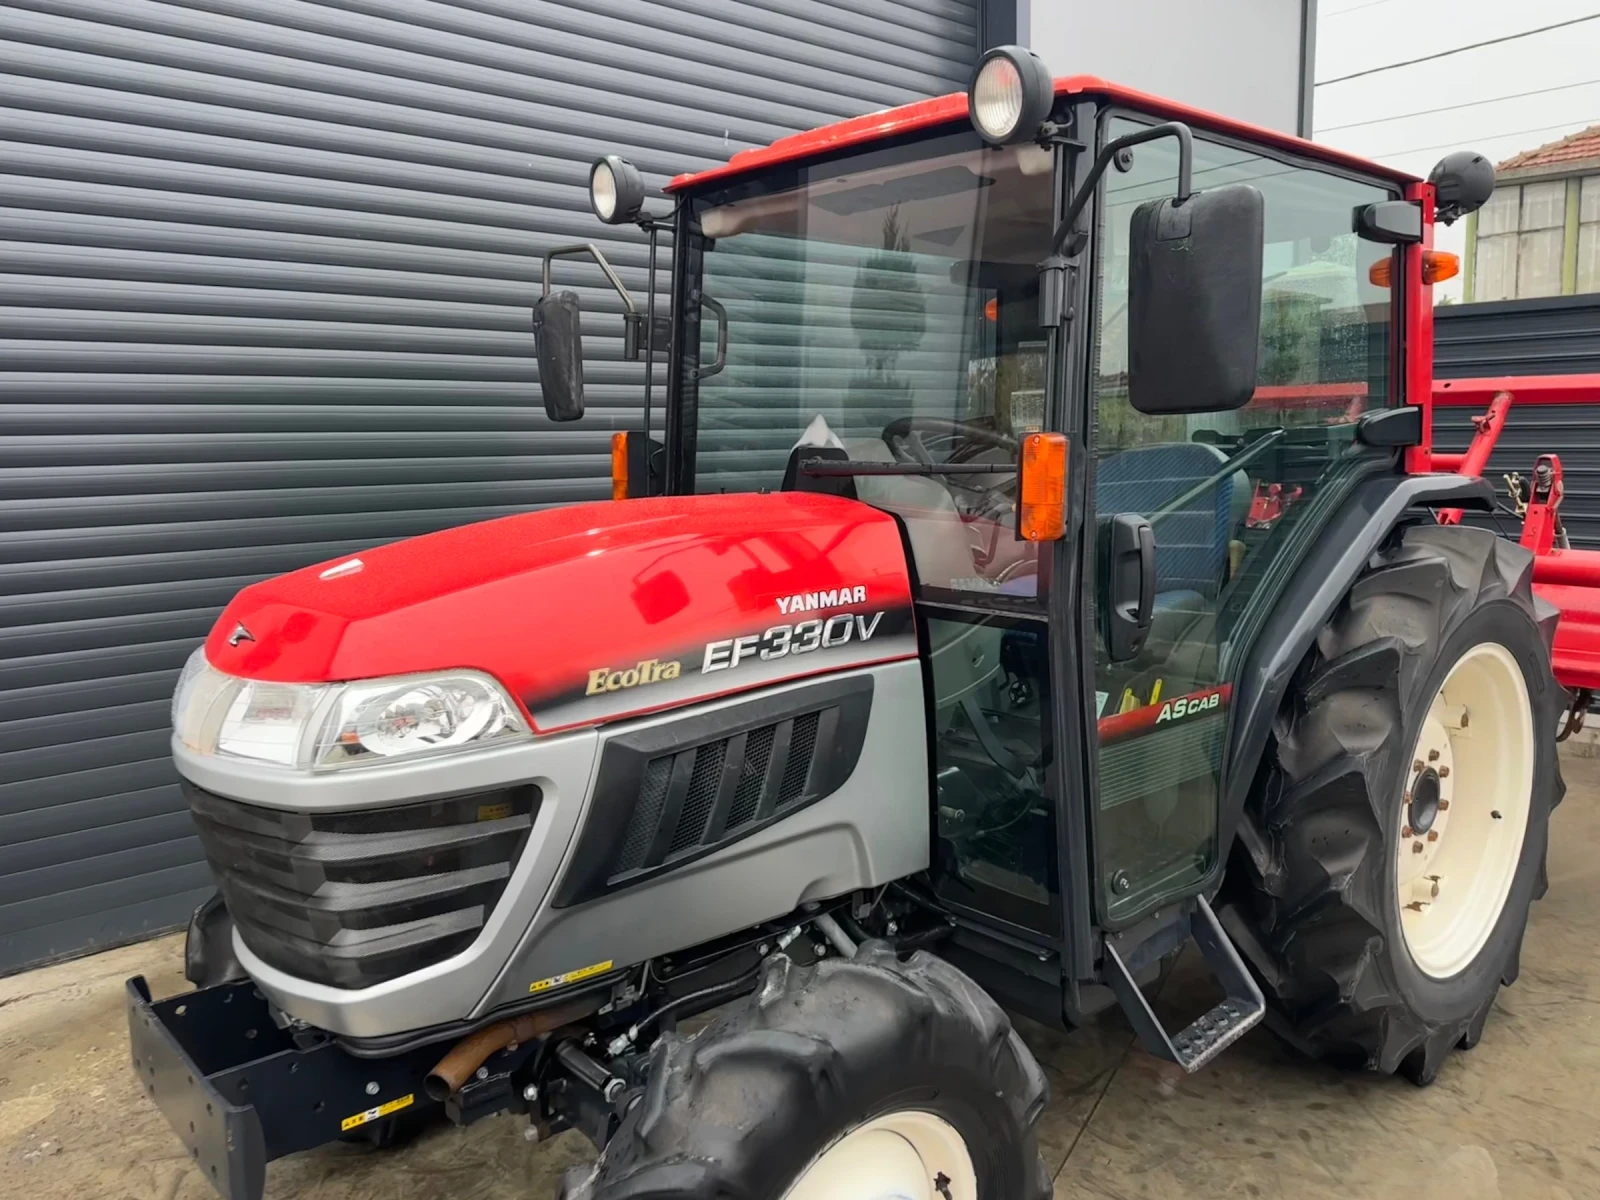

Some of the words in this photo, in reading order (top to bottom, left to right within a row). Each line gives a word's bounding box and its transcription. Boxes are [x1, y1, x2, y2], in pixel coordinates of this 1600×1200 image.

[776, 585, 866, 615] YANMAR
[701, 612, 885, 674] EF330V
[585, 658, 681, 696] EcoTra
